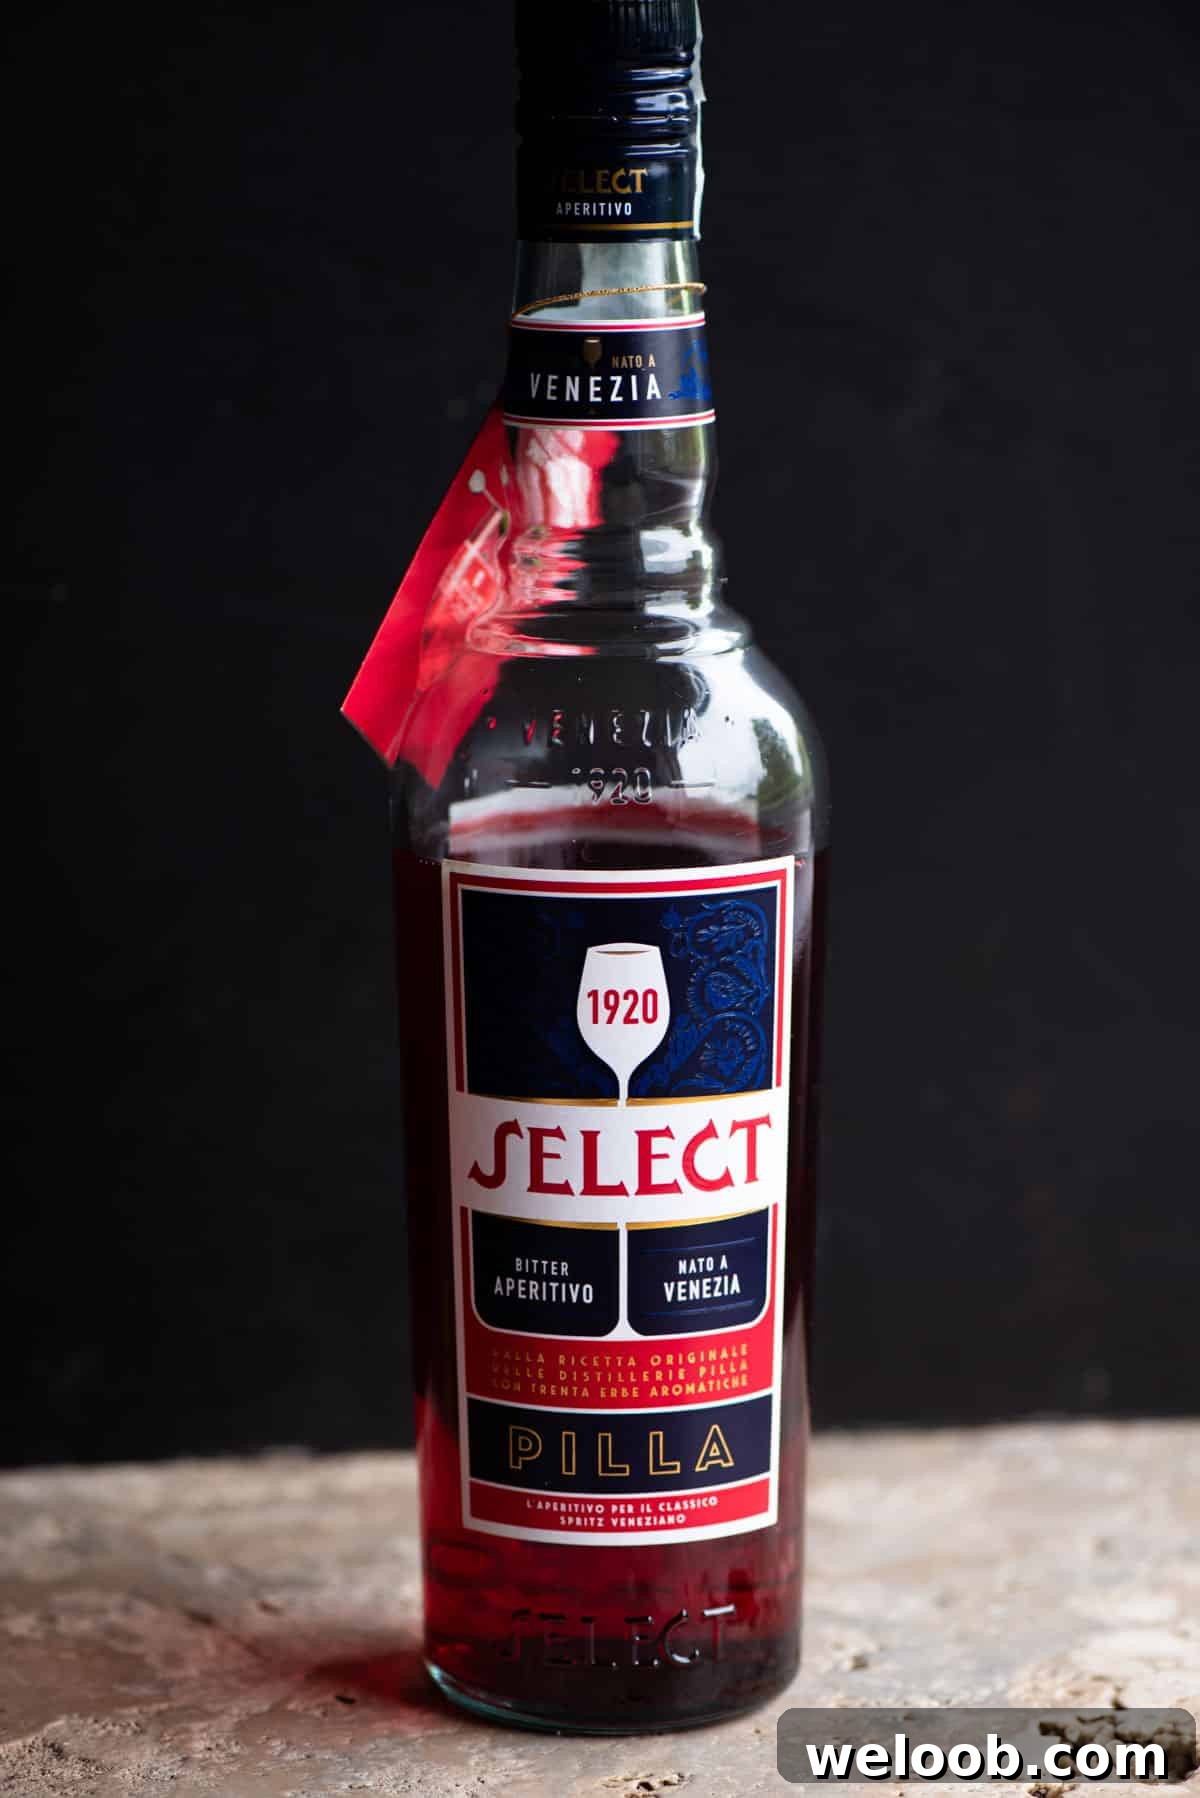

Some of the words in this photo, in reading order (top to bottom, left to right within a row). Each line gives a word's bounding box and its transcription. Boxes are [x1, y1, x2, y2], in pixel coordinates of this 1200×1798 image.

[548, 168, 648, 193] LECT
[556, 202, 633, 216] APERITIVO
[611, 355, 643, 369] NATO
[648, 354, 657, 368] A
[530, 372, 663, 402] VENEZIA
[587, 988, 660, 1026] 1920
[468, 1113, 773, 1197] SELECT
[515, 1257, 569, 1275] BITTER
[678, 1257, 714, 1275] NATO
[720, 1255, 728, 1270] A
[494, 1276, 593, 1303] APERITIVO
[664, 1274, 741, 1302] VENEZIA
[559, 1354, 638, 1368] RICETTA
[650, 1344, 748, 1366] ORIGINALE
[559, 1369, 686, 1383] DISTILLERIE
[699, 1359, 749, 1378] PILLA
[530, 1383, 590, 1398] TRENTA
[600, 1387, 640, 1398] ERBE
[650, 1374, 749, 1397] AROMATICHE
[508, 1424, 735, 1478] PILLA
[611, 1502, 635, 1514] PER
[640, 1501, 653, 1513] IL
[658, 1496, 719, 1512] CLASSICO
[559, 1515, 605, 1527] SPRITZ
[611, 1514, 687, 1527] VENEZIANO
